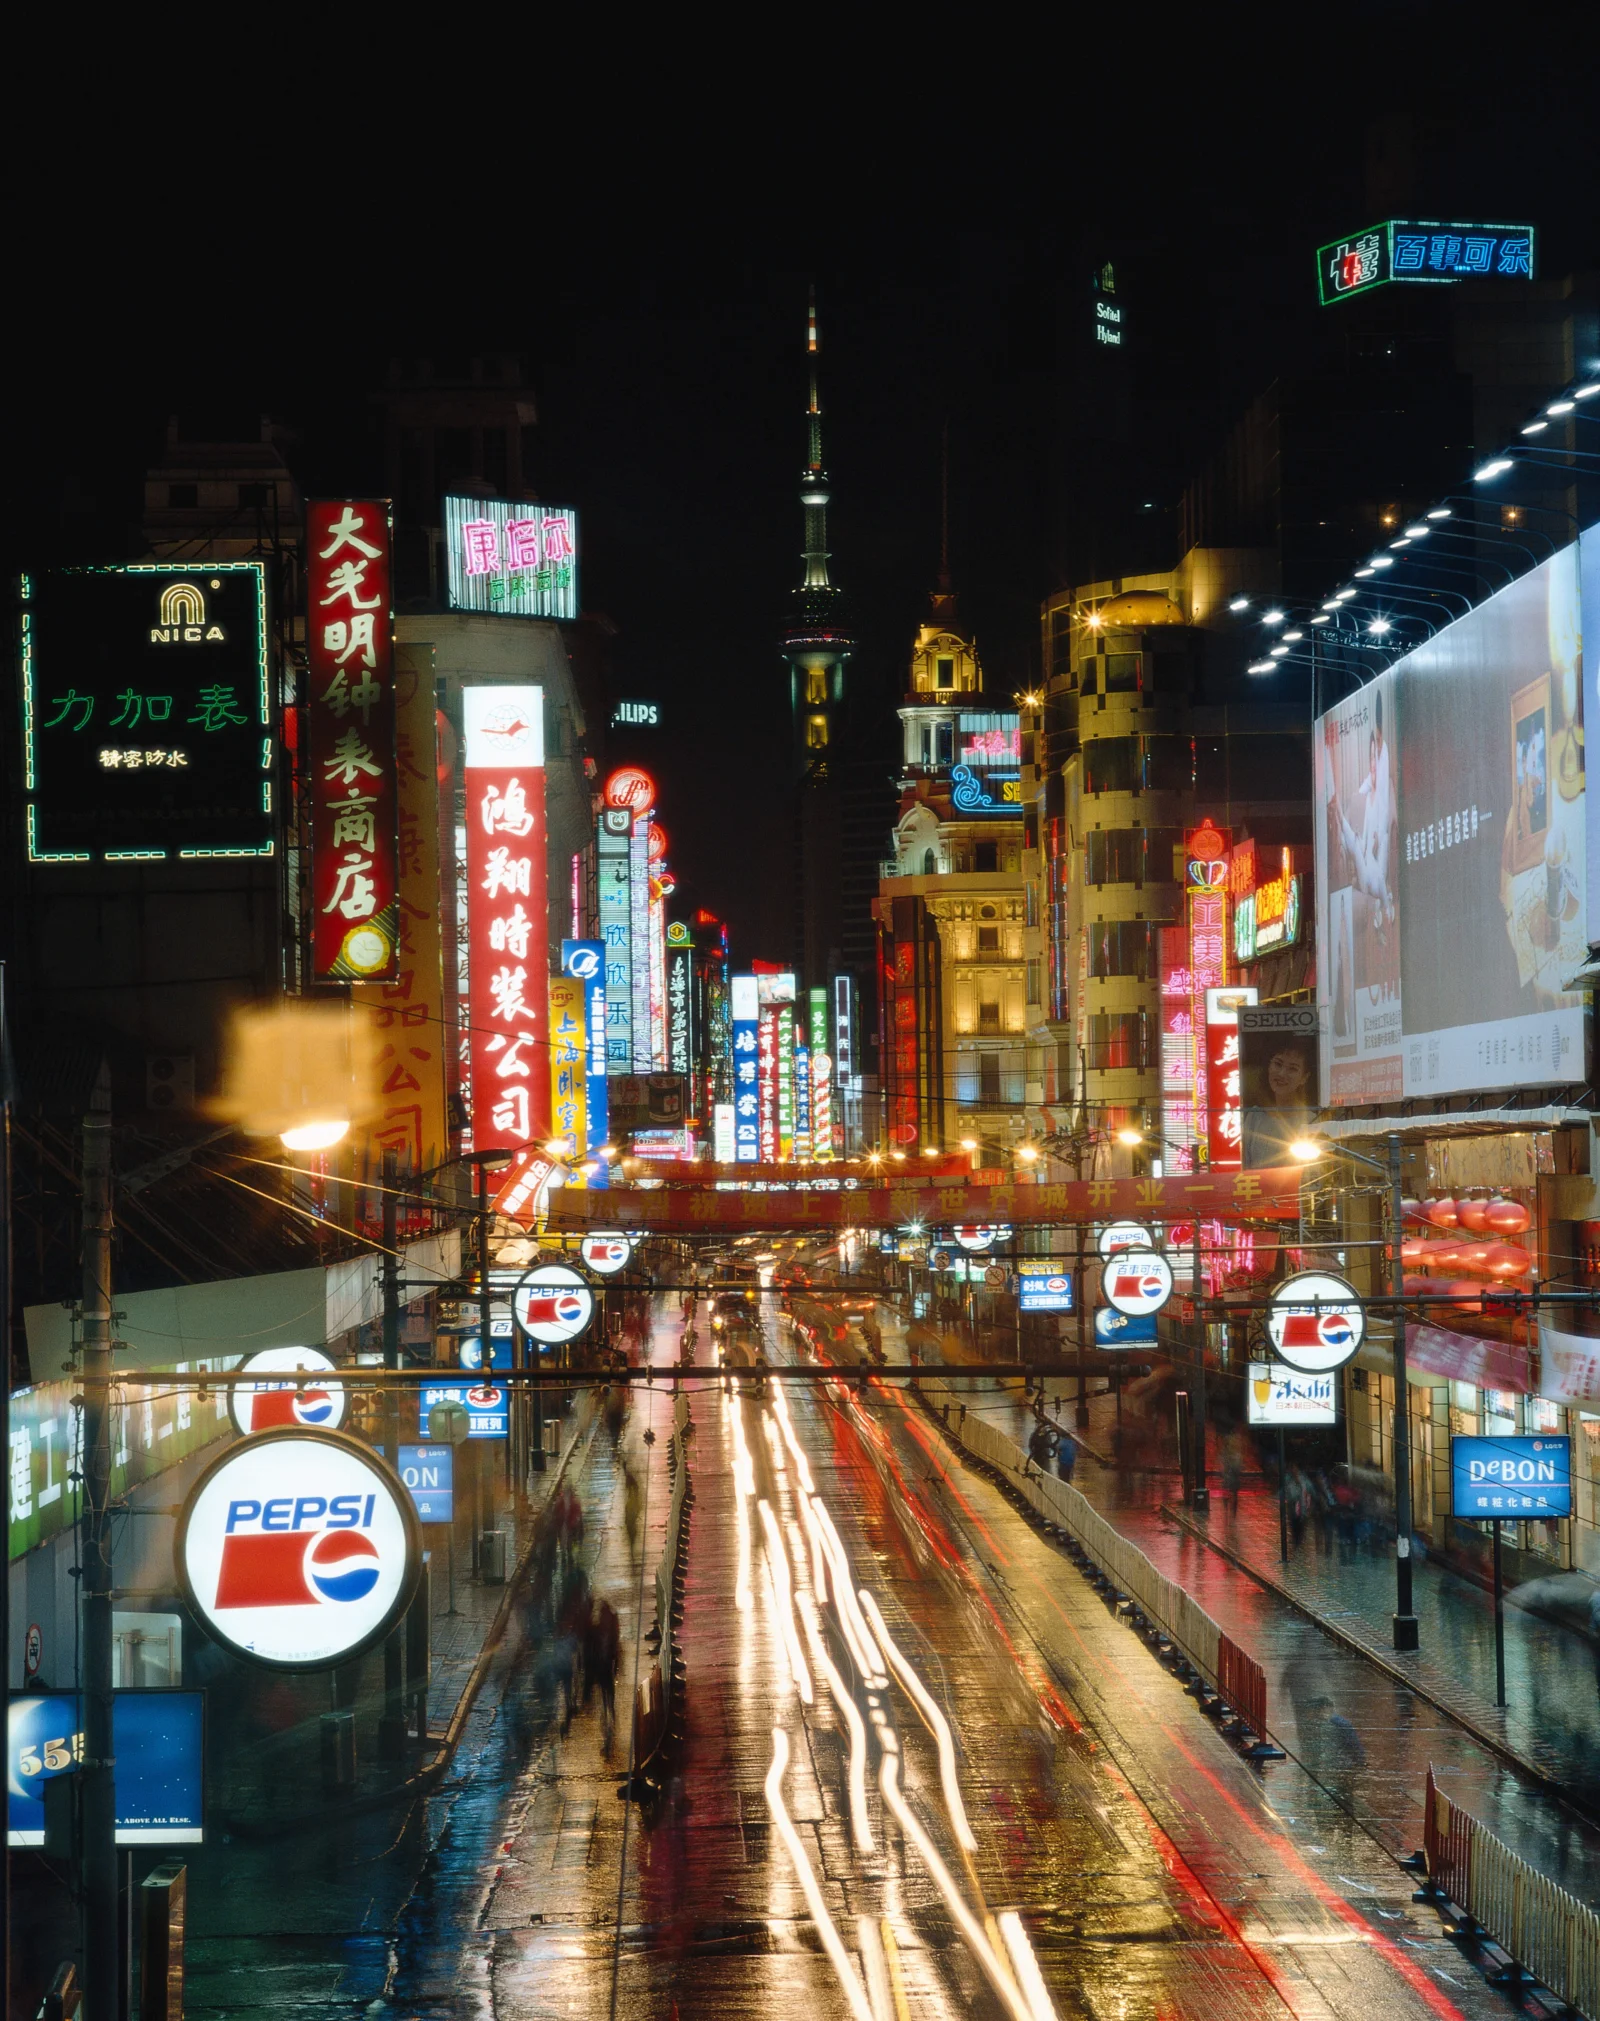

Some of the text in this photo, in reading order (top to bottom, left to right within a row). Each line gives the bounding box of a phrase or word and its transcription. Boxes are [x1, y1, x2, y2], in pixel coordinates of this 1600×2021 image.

[1395, 235, 1530, 272] 百事可乐
[1097, 303, 1120, 322] Sofitel
[1097, 324, 1120, 344] Hyland
[463, 518, 573, 576] 康培尔
[151, 627, 224, 642] NICA
[44, 684, 248, 731] 力加表
[319, 507, 384, 919] 大光明钟表商店
[604, 923, 629, 1063] 欣欣乐园
[1243, 1012, 1314, 1030] SEIKO
[1109, 1232, 1145, 1243] PEPSI
[1117, 1263, 1163, 1276] 百事可乐
[529, 1287, 580, 1298] PEPSI
[1276, 1379, 1331, 1399] Asahi
[1470, 1460, 1555, 1482] DeBON
[225, 1494, 376, 1533] PEPSI
